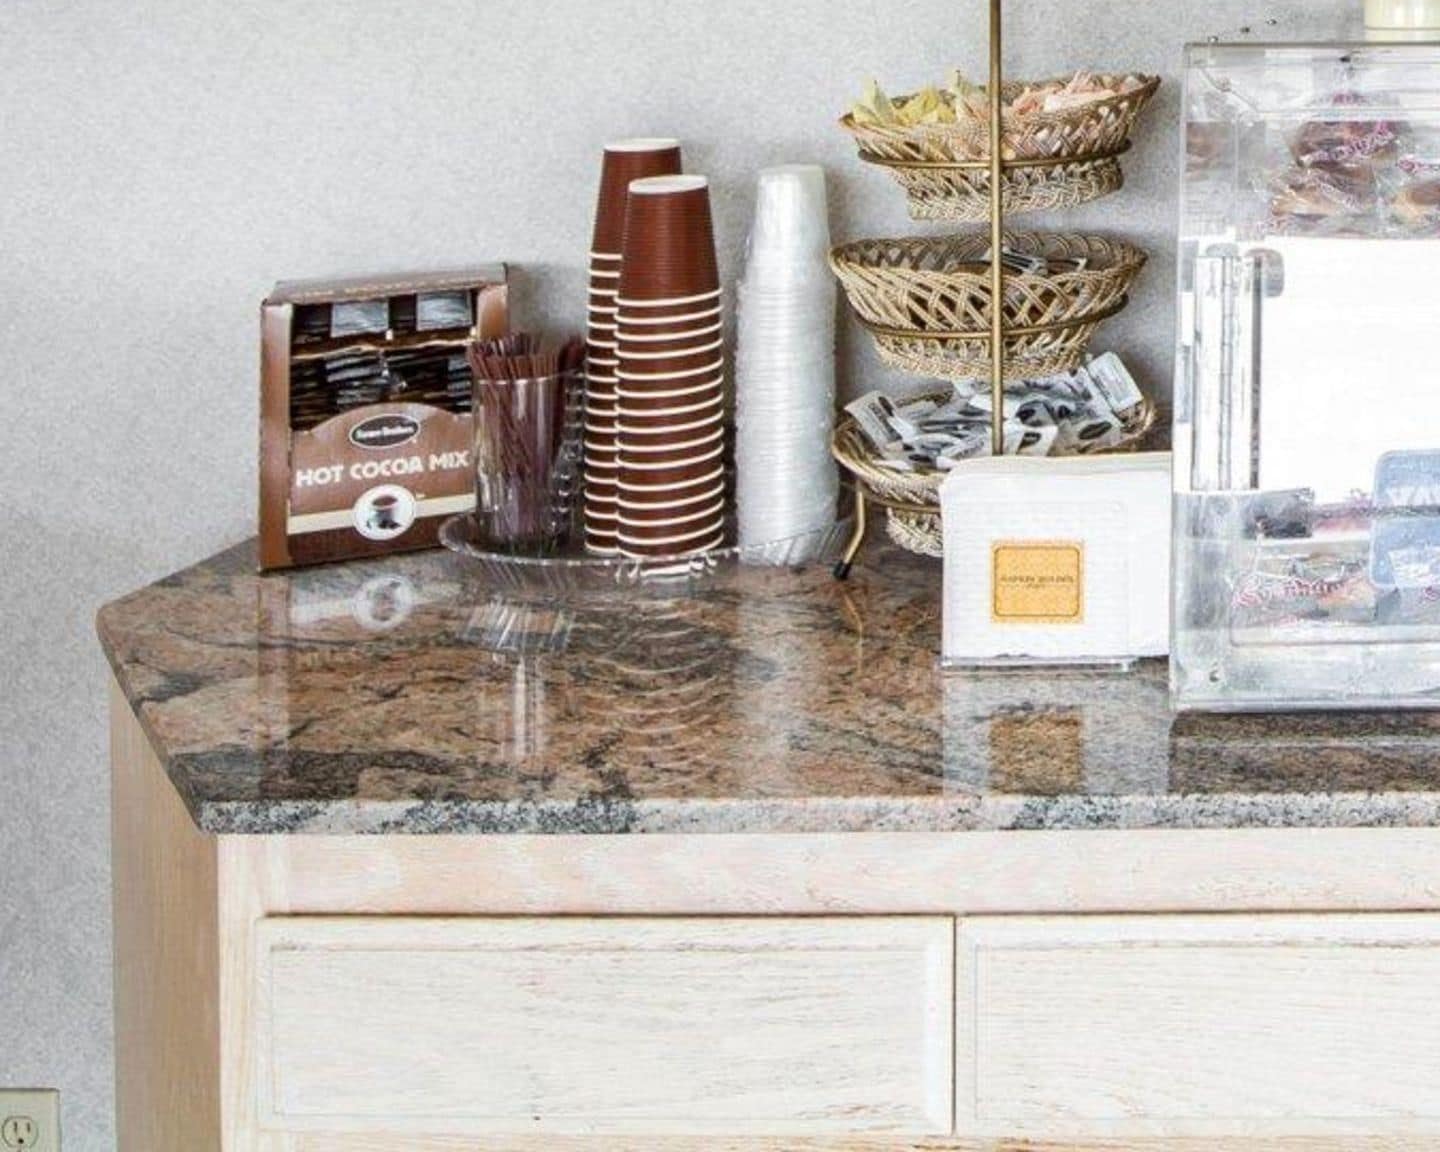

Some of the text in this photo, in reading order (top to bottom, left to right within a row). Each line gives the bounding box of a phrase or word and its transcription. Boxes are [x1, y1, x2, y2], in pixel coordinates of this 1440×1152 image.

[296, 450, 470, 488] HOT COCOA MIX
